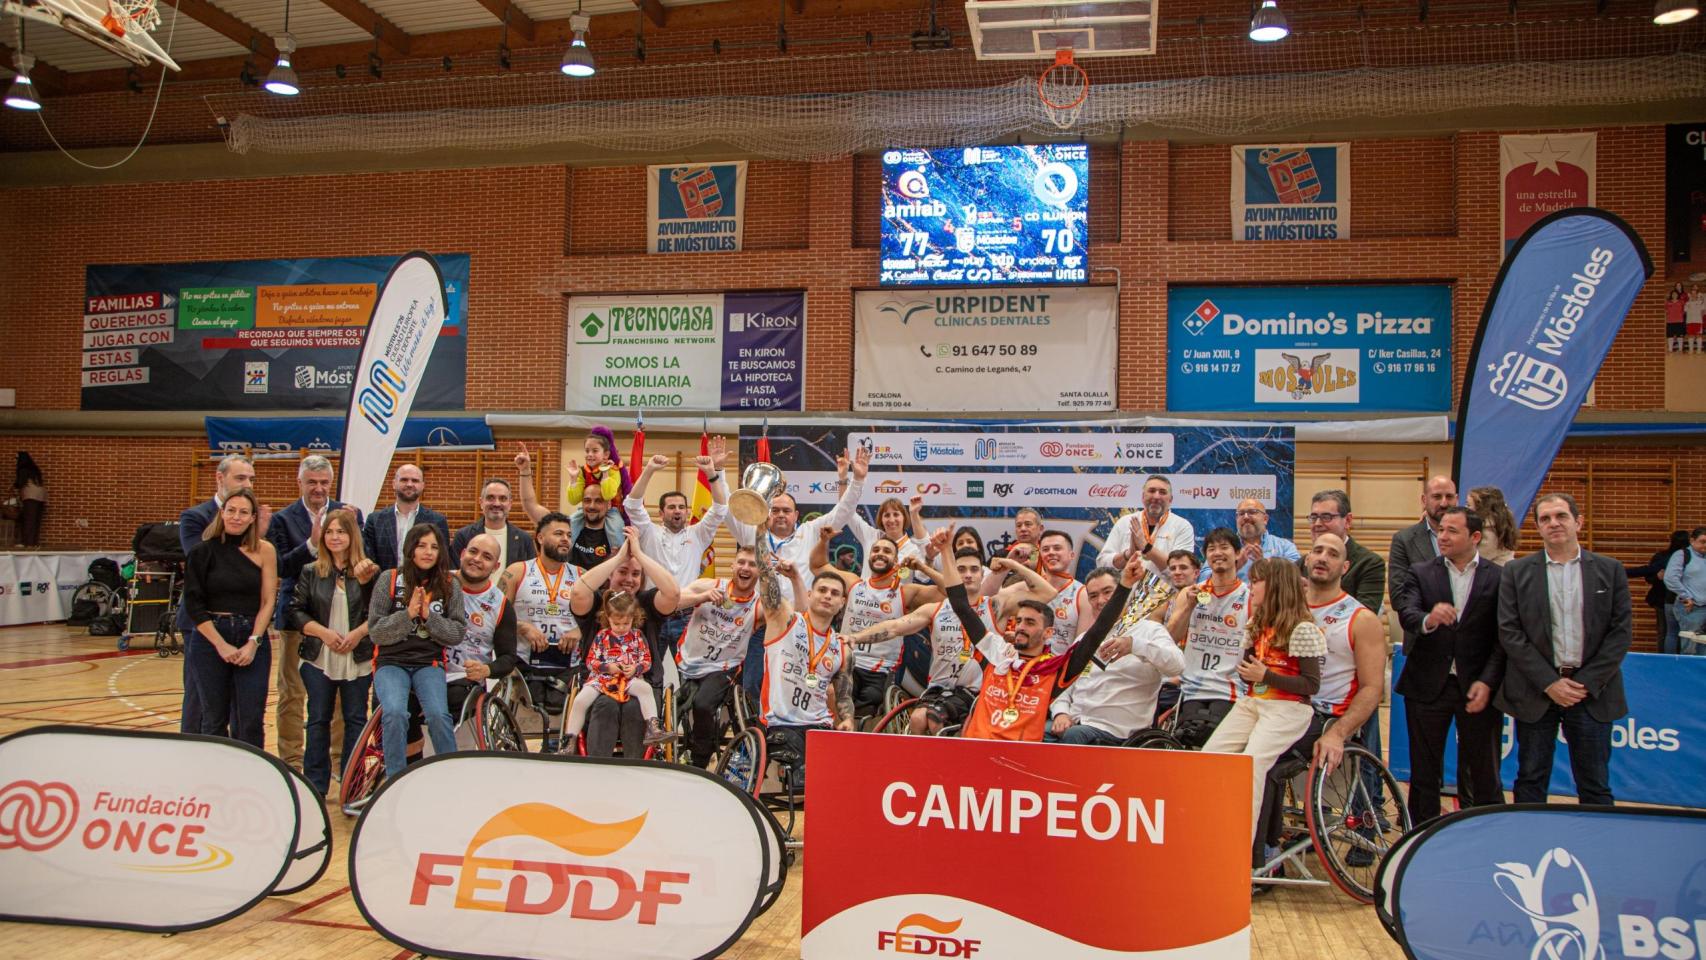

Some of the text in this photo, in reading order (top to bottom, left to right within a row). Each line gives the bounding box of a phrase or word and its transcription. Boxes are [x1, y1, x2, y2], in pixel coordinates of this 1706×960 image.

[1538, 188, 1577, 199] estrella
[1244, 206, 1337, 222] AYUNTAMIENTO
[1519, 202, 1532, 212] de
[657, 220, 737, 235] AYUNTAMIENTO
[1245, 222, 1338, 240] DE MÓSTOLES
[657, 234, 736, 253] DE MÓSTOLES
[899, 232, 930, 256] 77
[1041, 229, 1074, 253] 70
[89, 295, 154, 312] FAMILIAS
[935, 294, 1050, 314] URPIDENT
[1536, 246, 1614, 356] Móstoles
[89, 313, 167, 329] QUEREMOS
[402, 299, 419, 335] EUROPEA
[612, 305, 713, 332] TECNOCASA
[934, 315, 1050, 327] CLÍNICAS DENTALES
[1223, 311, 1432, 336] Domino's Pizza
[89, 331, 170, 348] JUGAR CON
[238, 330, 285, 339] RECORDAD
[287, 330, 305, 338] QUE
[307, 329, 343, 337] SIEMPRE
[612, 337, 669, 345] FRANCHISING
[250, 338, 360, 347] QUE SEGUIMOS VUESTROS
[395, 319, 418, 367] DEL DEPORTE
[739, 348, 785, 357] EN KIRON
[952, 344, 1037, 357] 91 647 50 89
[1183, 349, 1240, 360] C/ Juan XXIII, 9
[1368, 349, 1441, 359] C/ Iker Casillas, 24
[89, 352, 132, 366] ESTAS
[605, 356, 680, 369] SOMOS LA
[728, 360, 796, 370] TE BUSCAMOS
[945, 365, 974, 373] Camino
[976, 365, 985, 373] de
[987, 365, 1021, 374] Leganés,
[1195, 364, 1240, 373] 916 14 17 27
[1387, 363, 1401, 373] 916
[1404, 363, 1412, 373] 17
[1427, 363, 1436, 373] 16
[89, 369, 143, 384] REGLAS
[593, 375, 692, 388] INMOBILIARIA
[730, 373, 793, 382] LA HIPOTECA
[745, 385, 776, 394] HASTA
[601, 394, 683, 407] DEL BARRIO
[740, 398, 751, 407] EL
[754, 398, 771, 406] 100
[930, 447, 964, 456] Móstoles
[1065, 449, 1094, 457] ONCE
[1126, 450, 1163, 459] ONCE
[1193, 486, 1220, 499] play
[855, 599, 880, 608] amiab
[710, 608, 734, 622] amiab
[1196, 612, 1224, 623] amiab
[699, 624, 741, 642] gaviota
[1190, 632, 1240, 647] gaviota
[1201, 652, 1221, 671] 02
[791, 686, 812, 711] 88
[1611, 717, 1681, 752] oles
[94, 791, 212, 819] Fundación
[880, 781, 1165, 845] CAMPEÓN
[82, 818, 206, 858] ONCE
[409, 852, 690, 926] FEDDF
[878, 930, 982, 960] FEDDF
